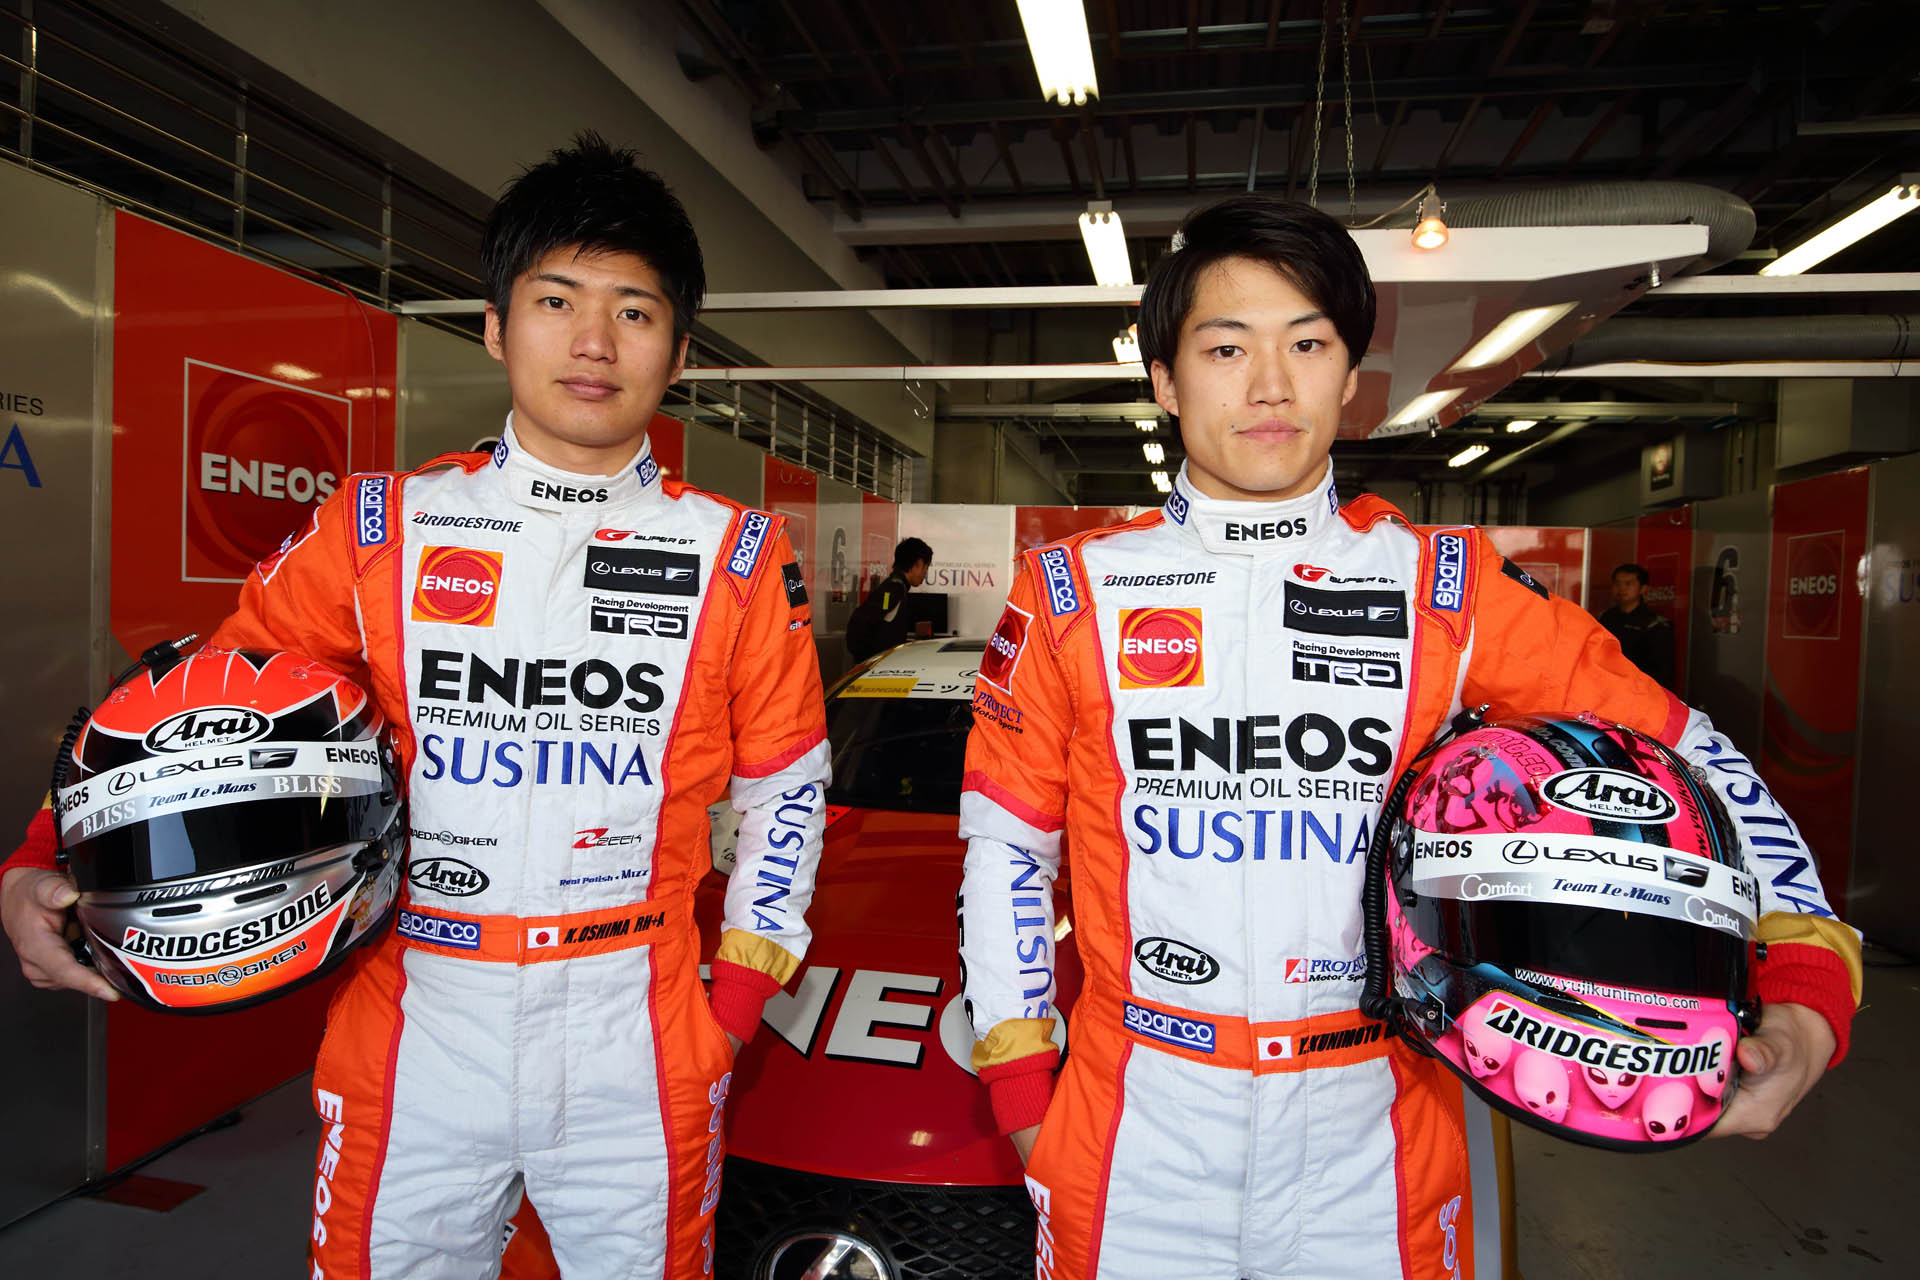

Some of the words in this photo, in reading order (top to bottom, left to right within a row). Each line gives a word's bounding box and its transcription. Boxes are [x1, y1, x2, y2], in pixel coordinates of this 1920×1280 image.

[201, 451, 337, 505] ENEOS
[530, 480, 609, 502] ENEOS
[361, 477, 384, 543] sparco
[412, 511, 524, 533] BRIDGESTONE
[633, 534, 677, 544] SUPER
[1225, 517, 1308, 542] ENEOS
[730, 513, 766, 577] sparco
[611, 566, 663, 577] LEXUS
[925, 568, 995, 588] USTINA
[1047, 550, 1076, 612] sparco
[1102, 571, 1217, 587] BRIDGESTONE
[1328, 575, 1376, 584] SUPER
[1436, 535, 1461, 606] sparco
[421, 575, 494, 596] ENEOS
[1790, 575, 1837, 596] ENEOS
[592, 596, 626, 608] Racing
[626, 600, 689, 612] Development
[1309, 606, 1364, 617] LEXUS
[595, 610, 683, 637] TRD
[990, 632, 1018, 659] ENEOS
[1123, 638, 1198, 655] ENEOS
[1293, 640, 1327, 655] Racing
[1329, 645, 1401, 660] Development
[419, 649, 665, 713] ENEOS
[1296, 656, 1396, 687] TRD
[153, 710, 255, 749] Arai
[416, 705, 527, 733] PREMIUM
[535, 711, 573, 731] OIL
[579, 713, 661, 736] SERIES
[184, 736, 232, 748] HELMET
[1128, 712, 1393, 776] ENEOS
[139, 755, 244, 783] LEXUS
[325, 747, 379, 766] ENEOS
[422, 733, 654, 788] SUSTINA
[148, 790, 188, 809] Team
[188, 786, 210, 800] Le
[211, 781, 258, 796] Mans
[272, 775, 343, 794] BLISS
[1134, 776, 1242, 801] PREMIUM
[1249, 776, 1292, 798] OIL
[1298, 777, 1384, 803] SERIES
[1552, 773, 1663, 812] Arai
[82, 800, 137, 838] BLISS
[1589, 802, 1640, 816] HELMET
[453, 837, 498, 847] GIKEN
[1414, 840, 1473, 860] ENEOS
[751, 783, 817, 931] SUSTINA
[1543, 846, 1659, 872] LEXUS
[409, 861, 480, 889] Arai
[430, 882, 462, 894] HELMET
[559, 878, 581, 887] Real
[1460, 874, 1533, 900] Comfort
[1551, 878, 1598, 893] Team
[1599, 882, 1623, 897] Le
[1626, 886, 1673, 906] Mans
[124, 882, 330, 957] BRIDGESTONE
[400, 912, 478, 941] sparco
[1684, 895, 1741, 933] Comfort
[563, 919, 629, 945] K.OSHIMA
[155, 972, 219, 986] MAEDA
[242, 940, 308, 977] GIKEN
[1138, 941, 1210, 975] Arai
[1154, 966, 1193, 981] HELMET
[1309, 973, 1344, 982] Motor
[1514, 967, 1700, 1011] www.yujikunimoto.com
[1125, 1003, 1213, 1043] sparco
[1297, 1023, 1382, 1056] Y.KUNIMOTO
[1485, 1001, 1723, 1078] BRIDGESTONE
